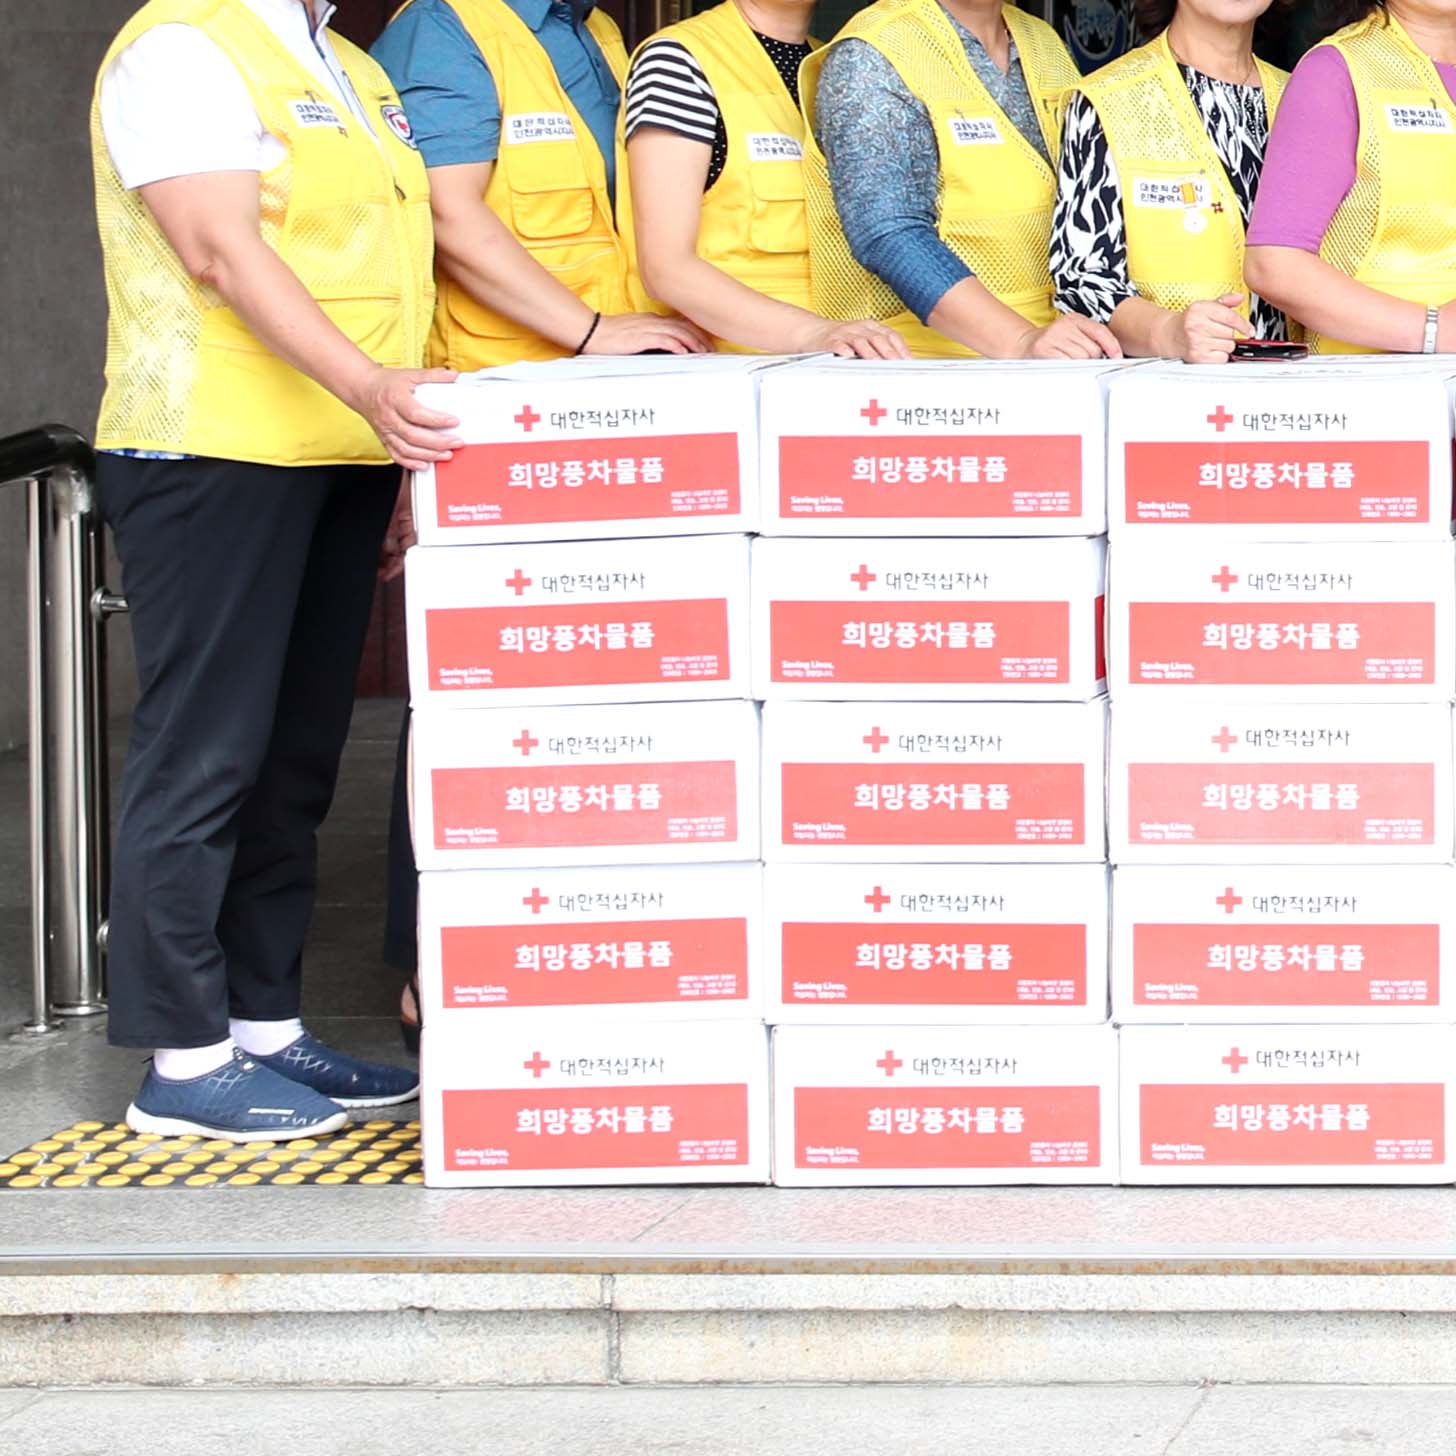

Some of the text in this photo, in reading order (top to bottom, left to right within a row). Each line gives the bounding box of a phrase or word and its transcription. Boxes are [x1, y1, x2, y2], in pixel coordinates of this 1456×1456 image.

[550, 408, 656, 430] 대한적십자사
[896, 406, 1001, 426] 대한적십자사
[1242, 412, 1348, 432] 대한적십자사
[508, 457, 665, 489] 희망풍차물품
[852, 456, 1008, 484] 희망풍차물품
[1198, 462, 1355, 489] 희망풍차물품
[541, 572, 646, 593] 대한적십자사
[885, 571, 989, 591] 대한적십자사
[1247, 572, 1353, 591] 대한적십자사
[499, 622, 655, 653] 희망풍차물품
[842, 621, 996, 649] 희망풍차물품
[1202, 623, 1361, 650] 희망풍차물품
[548, 735, 652, 756] 대한적십자사
[898, 733, 1003, 753] 대한적십자사
[1245, 728, 1350, 748] 대한적십자사
[505, 783, 662, 813] 희망풍차물품
[854, 783, 1011, 811] 희망풍차물품
[1202, 783, 1361, 811] 희망풍차물품
[559, 892, 664, 912] 대한적십자사
[900, 893, 1004, 913] 대한적십자사
[1252, 895, 1357, 914] 대한적십자사
[515, 940, 673, 972] 희망풍차물품
[855, 943, 1013, 971] 희망풍차물품
[1207, 944, 1365, 972] 희망풍차물품
[559, 1057, 665, 1077] 대한적십자사
[912, 1056, 1018, 1076] 대한적십자사
[1255, 1049, 1361, 1068] 대한적십자사
[516, 1105, 674, 1135] 희망풍차물품
[867, 1106, 1025, 1134] 희망풍차물품
[1213, 1103, 1371, 1131] 희망풍차물품
